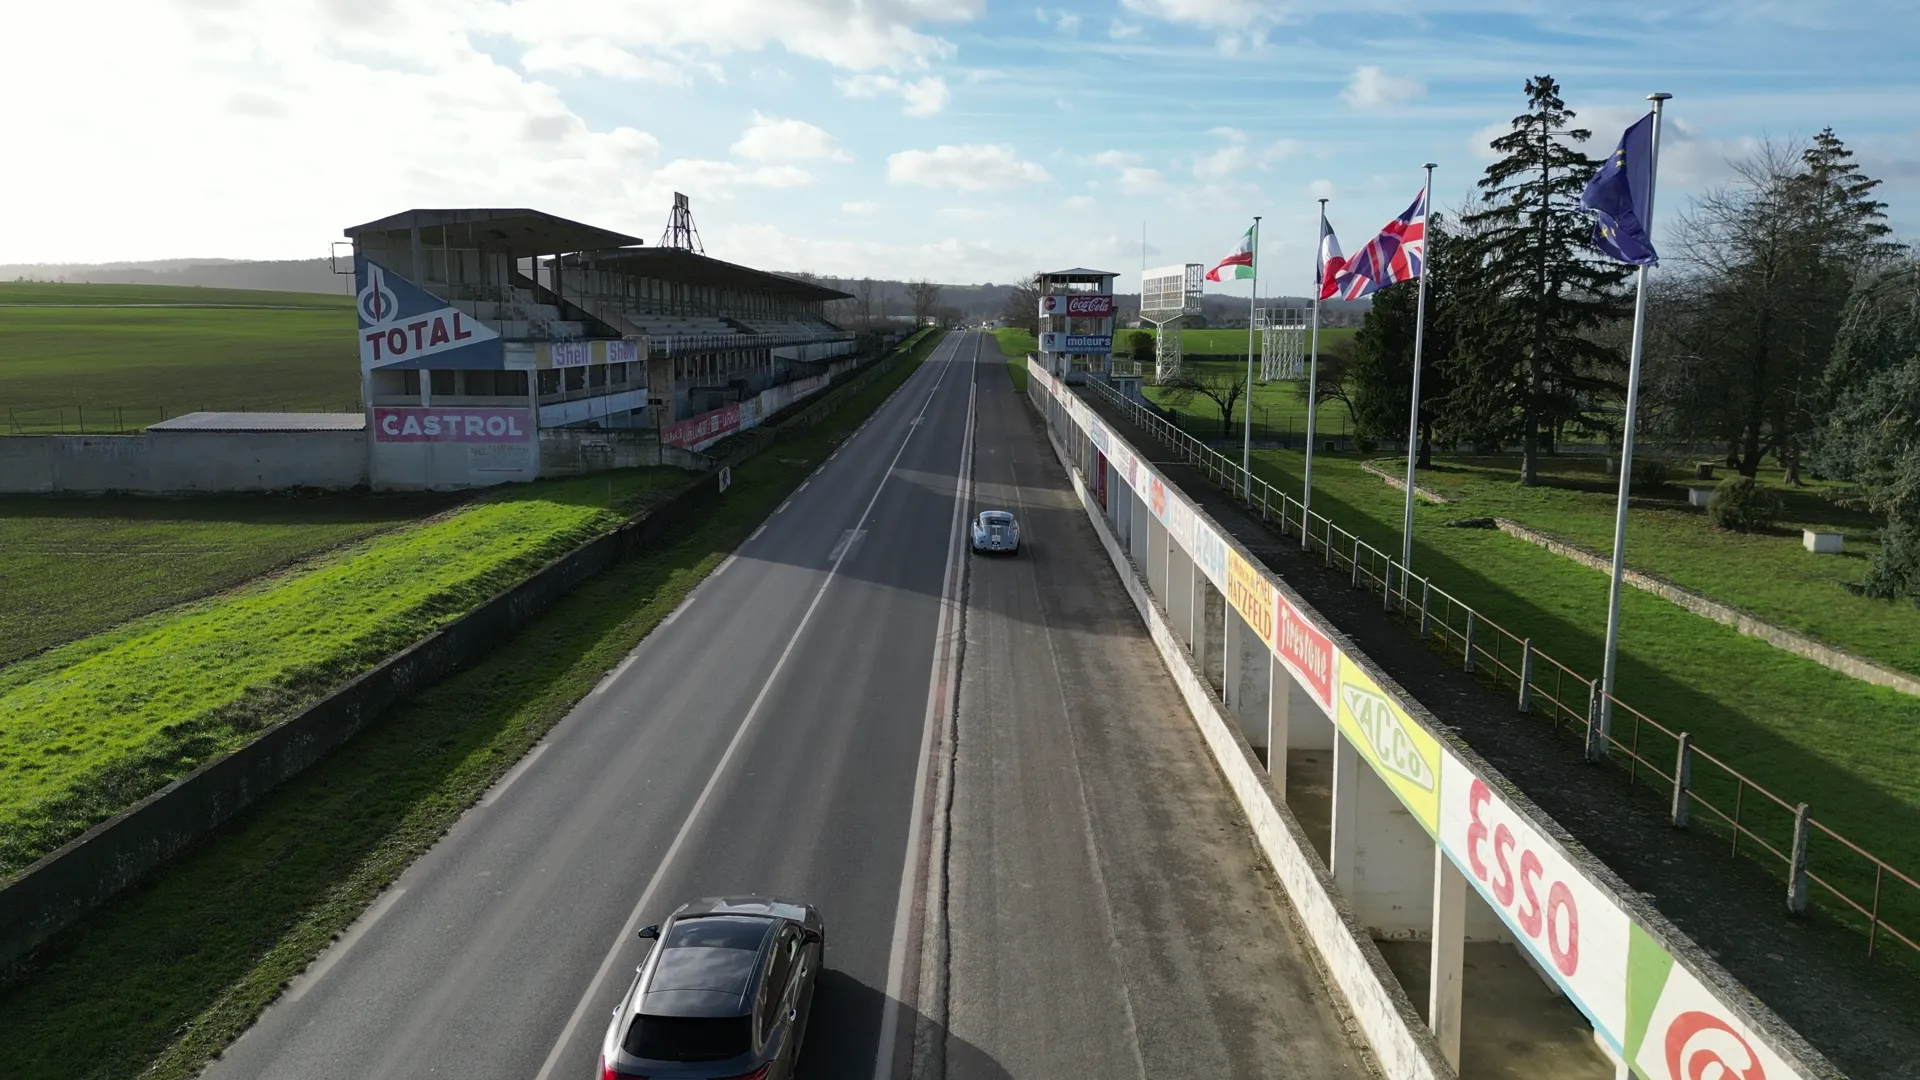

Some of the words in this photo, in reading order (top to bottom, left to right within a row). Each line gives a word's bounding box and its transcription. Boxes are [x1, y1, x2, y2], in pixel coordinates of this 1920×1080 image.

[1069, 297, 1111, 313] Coca-Cola
[366, 312, 472, 361] TOTAL
[556, 341, 589, 365] Shell
[1067, 336, 1111, 346] moteurs
[382, 415, 523, 436] CASTROL
[1228, 572, 1272, 641] HATZFELD
[1281, 604, 1327, 684] Firestone
[1348, 689, 1421, 778] YACCO
[1467, 777, 1579, 977] ESSO
